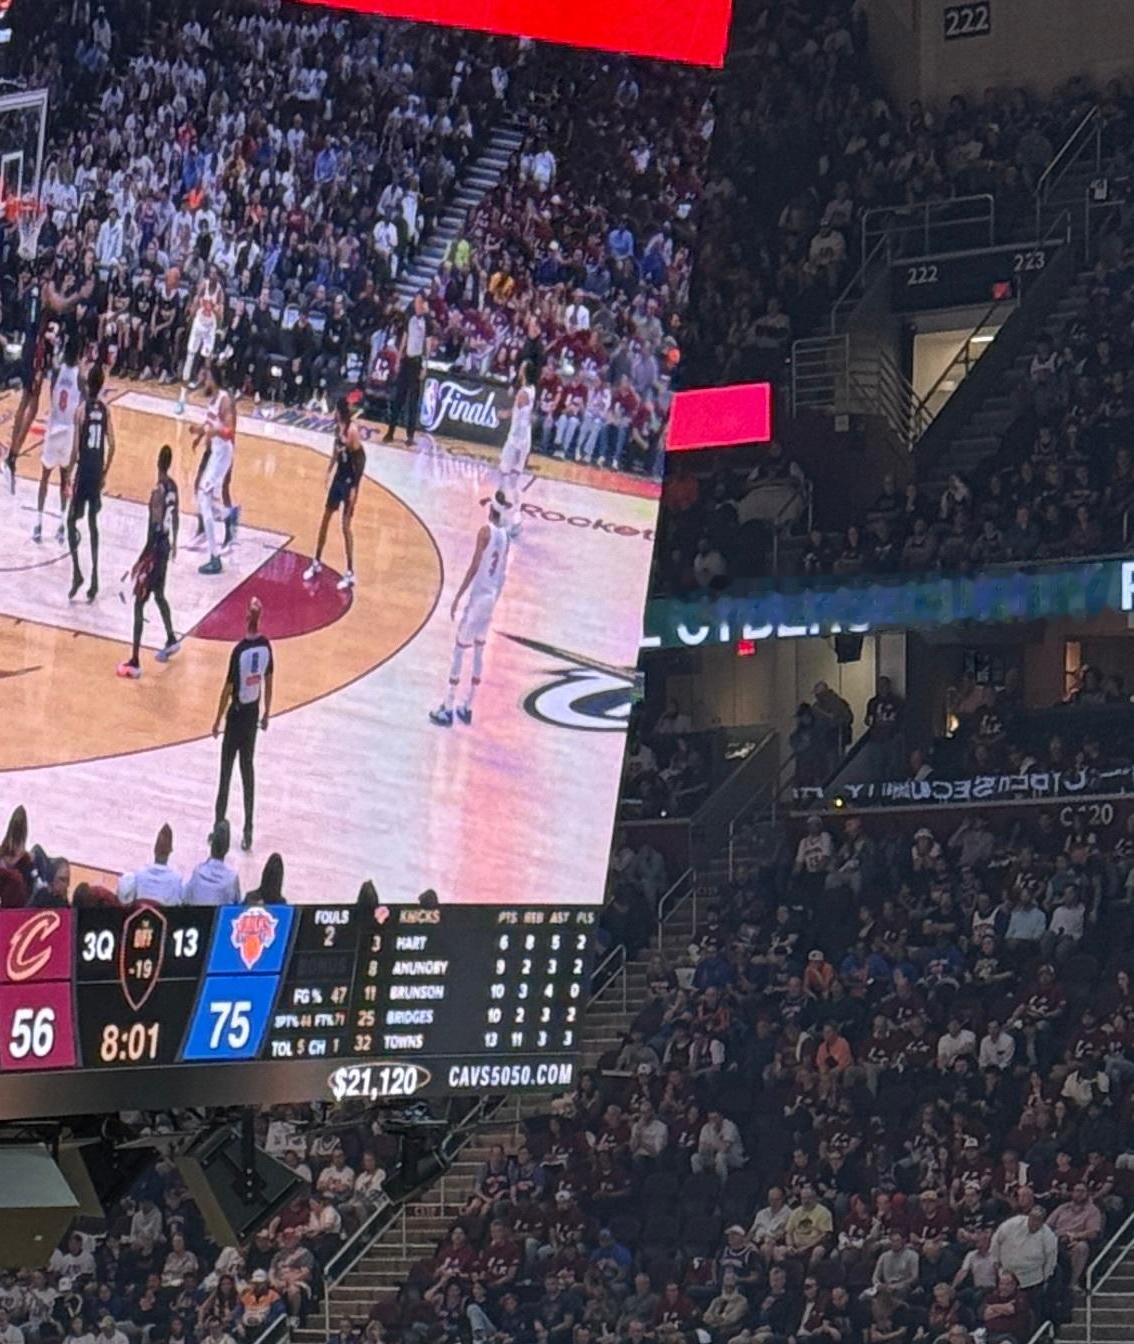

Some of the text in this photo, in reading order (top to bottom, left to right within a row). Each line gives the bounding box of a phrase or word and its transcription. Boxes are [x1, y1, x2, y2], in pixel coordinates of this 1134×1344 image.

[945, 6, 989, 36] 222
[907, 252, 1045, 285] 222 223
[437, 380, 500, 429] Finals
[315, 910, 349, 925] FOULS
[399, 910, 440, 923] KNICKS
[82, 931, 115, 961] 3Q
[173, 928, 199, 958] 13
[325, 927, 335, 947] 2
[372, 934, 586, 951] 3 HART 6 8 5 2
[128, 960, 153, 980] -19
[392, 959, 583, 975] ANUNOBY 9 2 3 2
[331, 986, 347, 1003] 47
[365, 983, 553, 1001] 11 BRUNSON 10 3 4
[209, 1001, 251, 1049] 75
[357, 1010, 375, 1026] 25
[387, 1010, 434, 1024] BRIDGES
[487, 1009, 501, 1023] 10
[515, 1008, 524, 1023] 2
[541, 1007, 550, 1022] 3
[567, 1007, 576, 1022] 2
[9, 1007, 55, 1058] 56
[101, 1023, 160, 1062] 8:01
[354, 1031, 572, 1051] 32 TOWNS 13 11 3 3
[272, 1040, 325, 1056] TOL CH
[332, 1063, 572, 1100] $21,120 CAVS5050.COM
